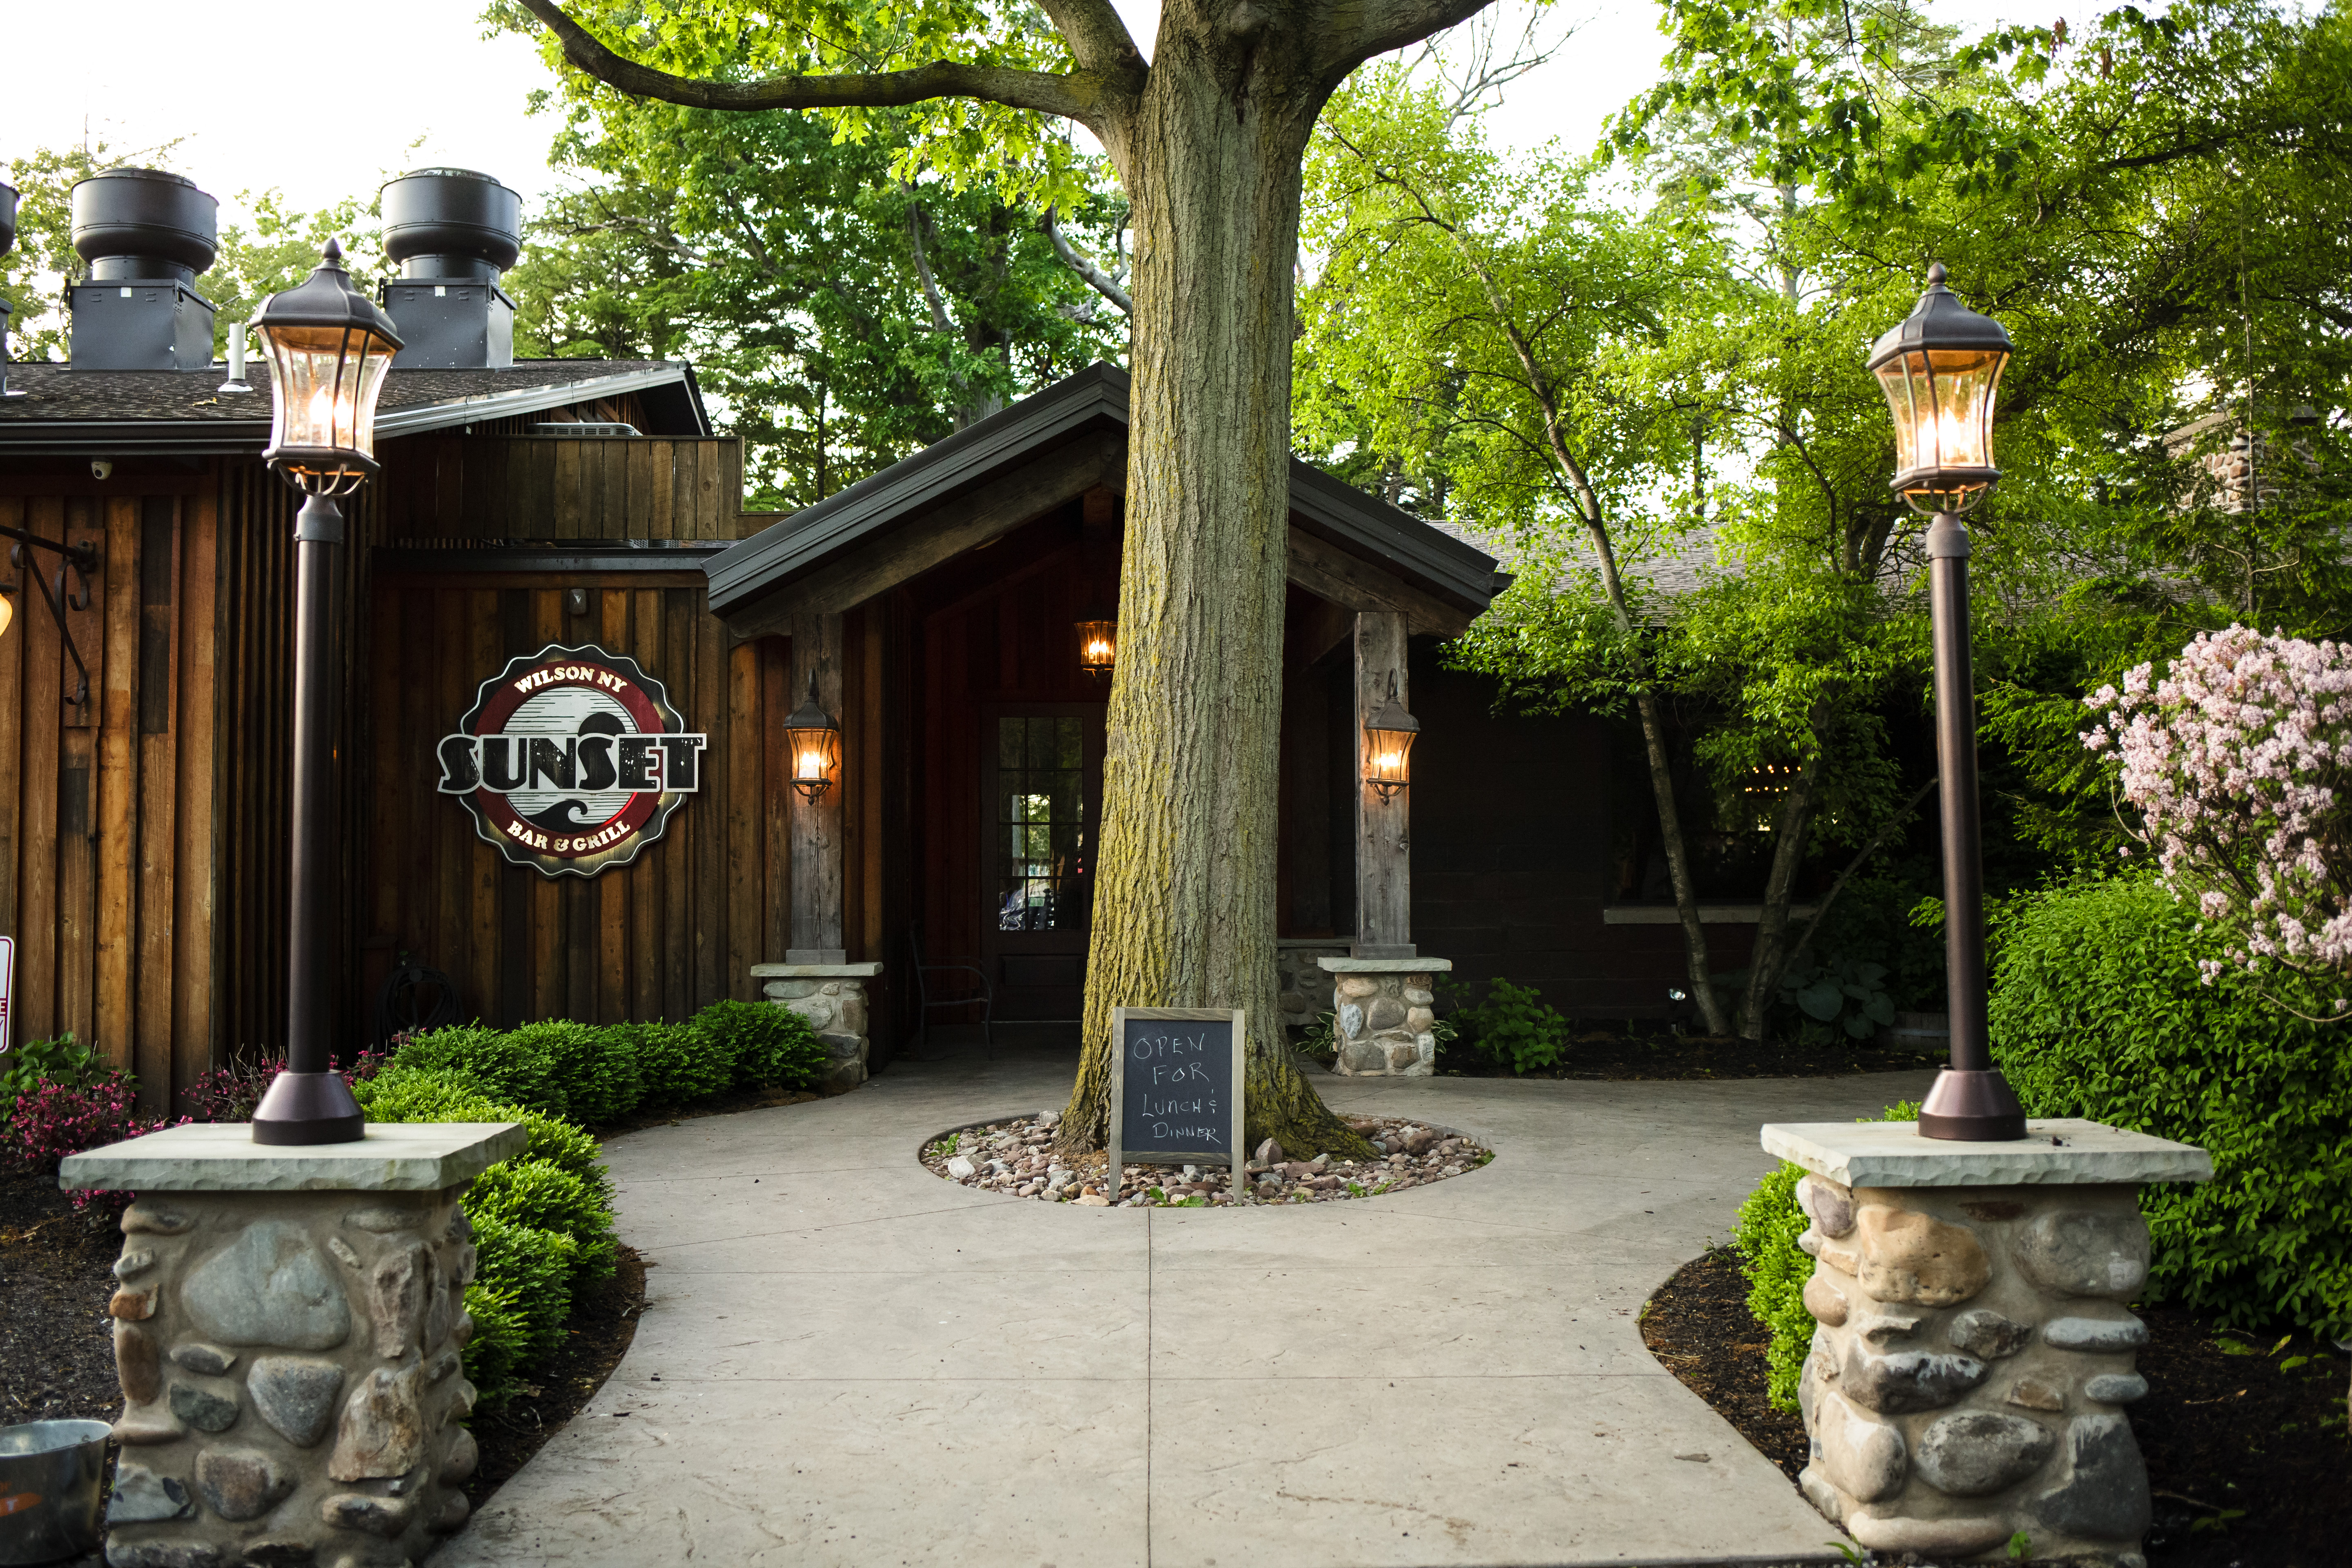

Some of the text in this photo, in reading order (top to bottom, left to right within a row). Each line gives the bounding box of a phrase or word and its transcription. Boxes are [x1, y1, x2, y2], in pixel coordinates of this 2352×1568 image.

[514, 666, 627, 693] WILSON NY
[437, 733, 707, 794] SUNSET
[507, 820, 630, 851] BAR & GRILL
[1134, 1033, 1205, 1059] OPEN
[1154, 1062, 1209, 1085] FOR
[1143, 1094, 1200, 1117] LUNCH
[1153, 1122, 1222, 1144] DINNER
